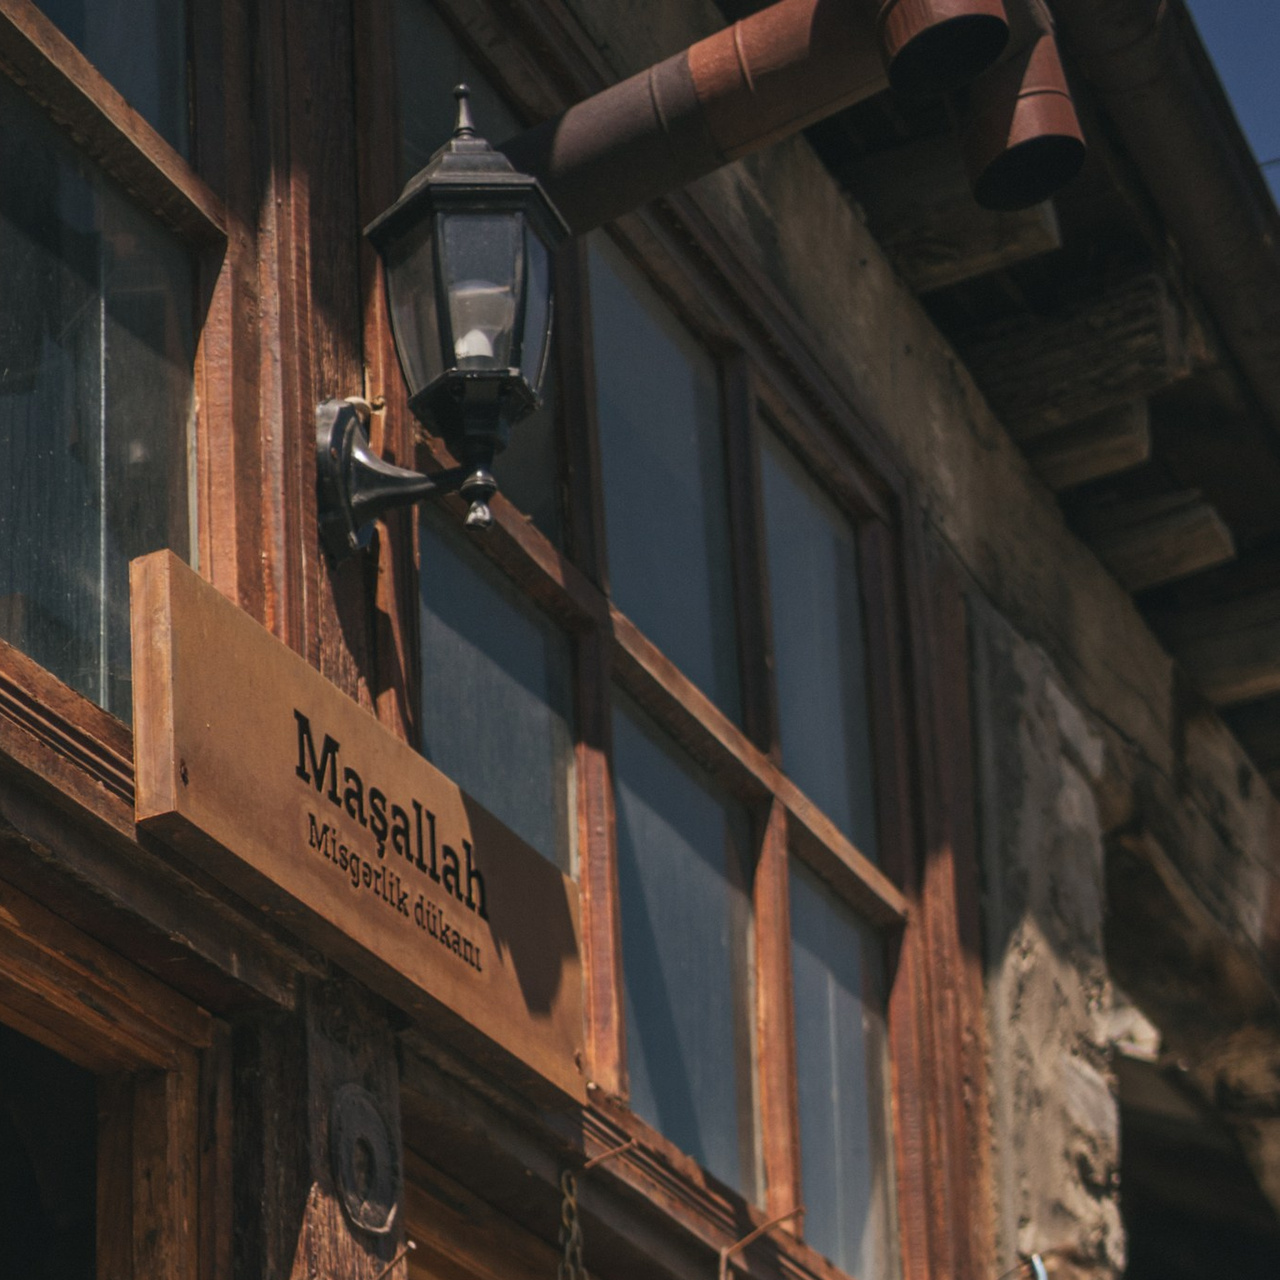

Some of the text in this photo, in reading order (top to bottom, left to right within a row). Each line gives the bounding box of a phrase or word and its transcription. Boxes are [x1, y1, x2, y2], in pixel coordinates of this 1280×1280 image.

[294, 708, 489, 922] Maşallah
[308, 813, 482, 972] Misgərlik dükanı
